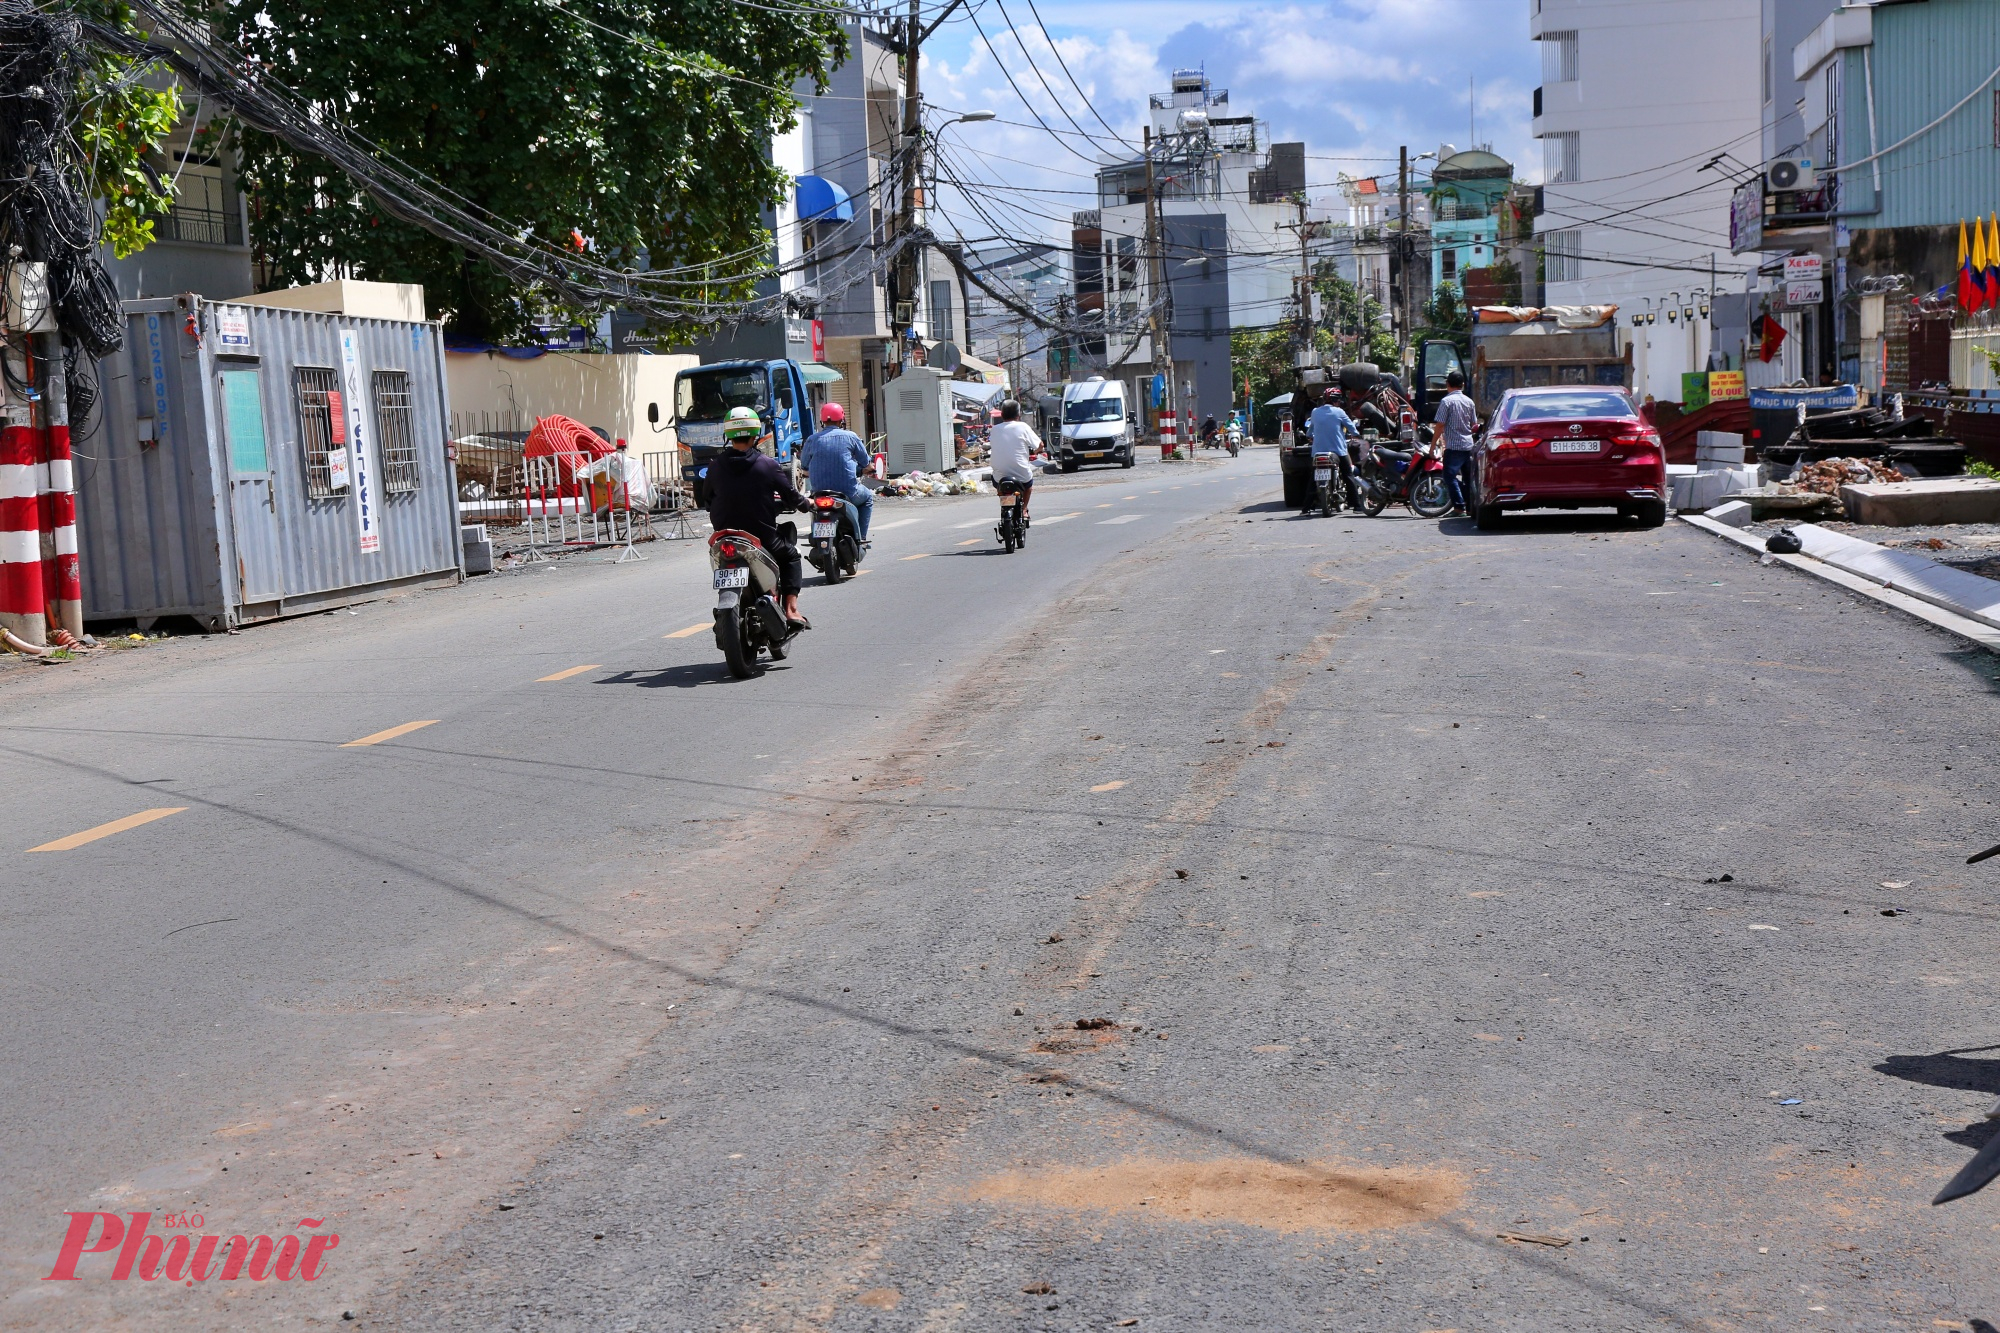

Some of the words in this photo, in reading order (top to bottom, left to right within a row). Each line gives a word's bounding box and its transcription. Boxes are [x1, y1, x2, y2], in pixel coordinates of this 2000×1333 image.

[1711, 388, 1723, 397] CÔ
[1753, 397, 1780, 408] PHỤC
[1782, 398, 1796, 408] VỤ
[1552, 441, 1598, 451] 51H-636.38
[718, 568, 743, 579] 90-B1
[715, 577, 746, 588] 683.30
